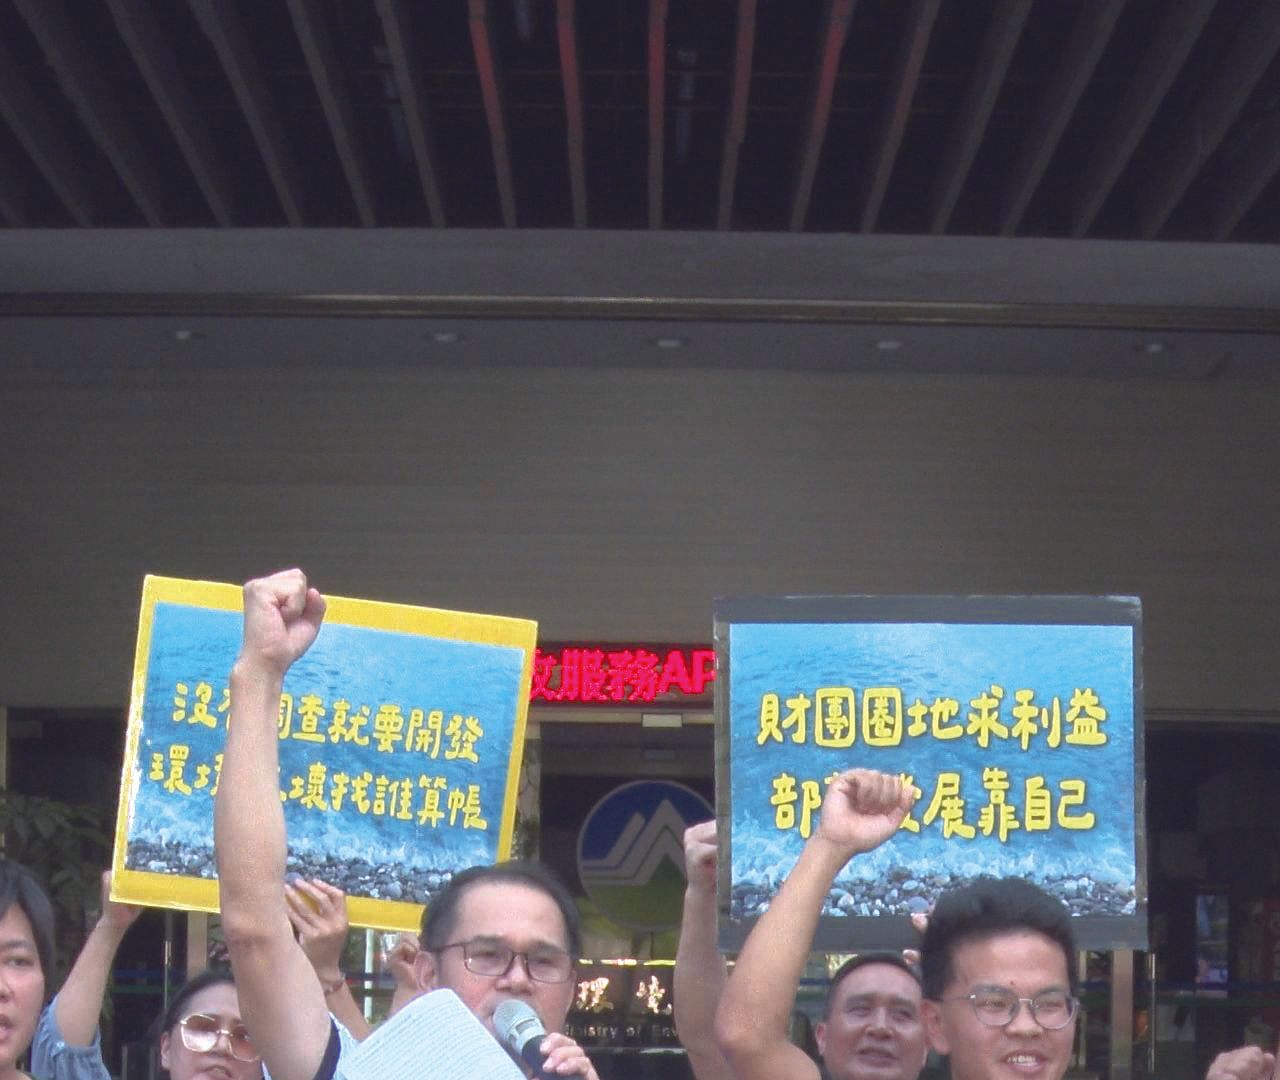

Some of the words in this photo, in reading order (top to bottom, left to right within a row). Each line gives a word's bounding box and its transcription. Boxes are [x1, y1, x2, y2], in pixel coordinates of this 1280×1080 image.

[172, 681, 485, 763] 沒查就要開發
[756, 685, 1108, 748] 財團圈地求利益
[149, 744, 488, 831] 環壞找誰算帳
[770, 767, 1096, 842] 部展靠自己
